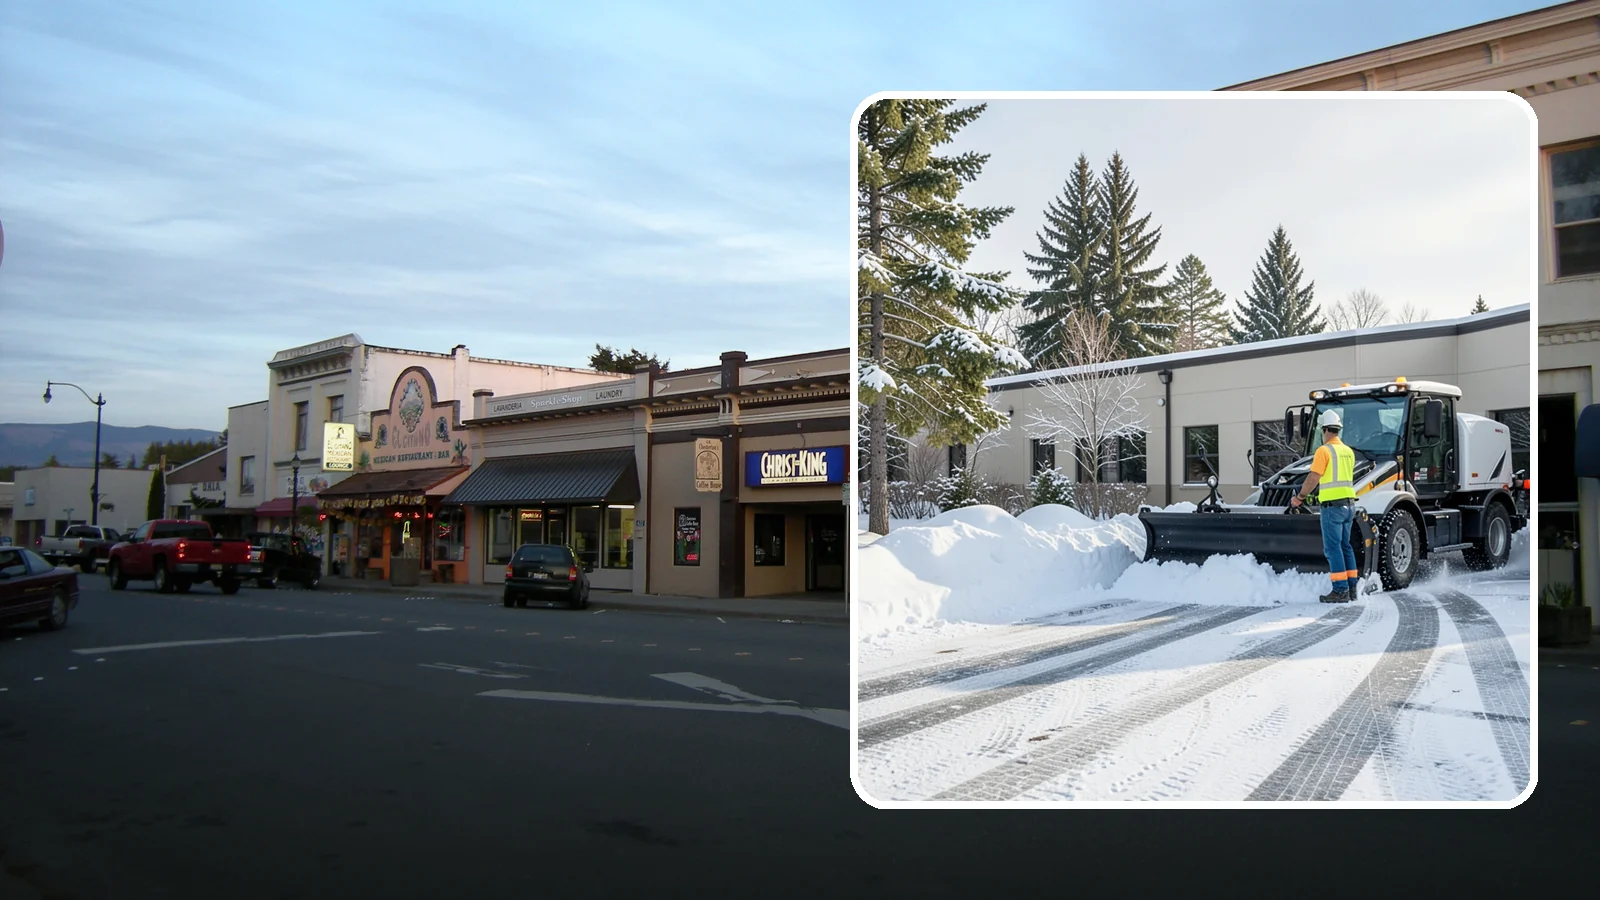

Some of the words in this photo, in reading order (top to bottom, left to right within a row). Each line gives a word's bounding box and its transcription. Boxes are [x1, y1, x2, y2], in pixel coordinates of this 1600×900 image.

[595, 389, 623, 399] LAUNDRY
[561, 395, 582, 406] Shop
[493, 402, 522, 412] LAVANDERIA
[398, 451, 433, 462] RESTAURANT
[438, 450, 449, 459] BAR
[761, 452, 797, 478] CHRIST
[799, 450, 827, 476] KING
